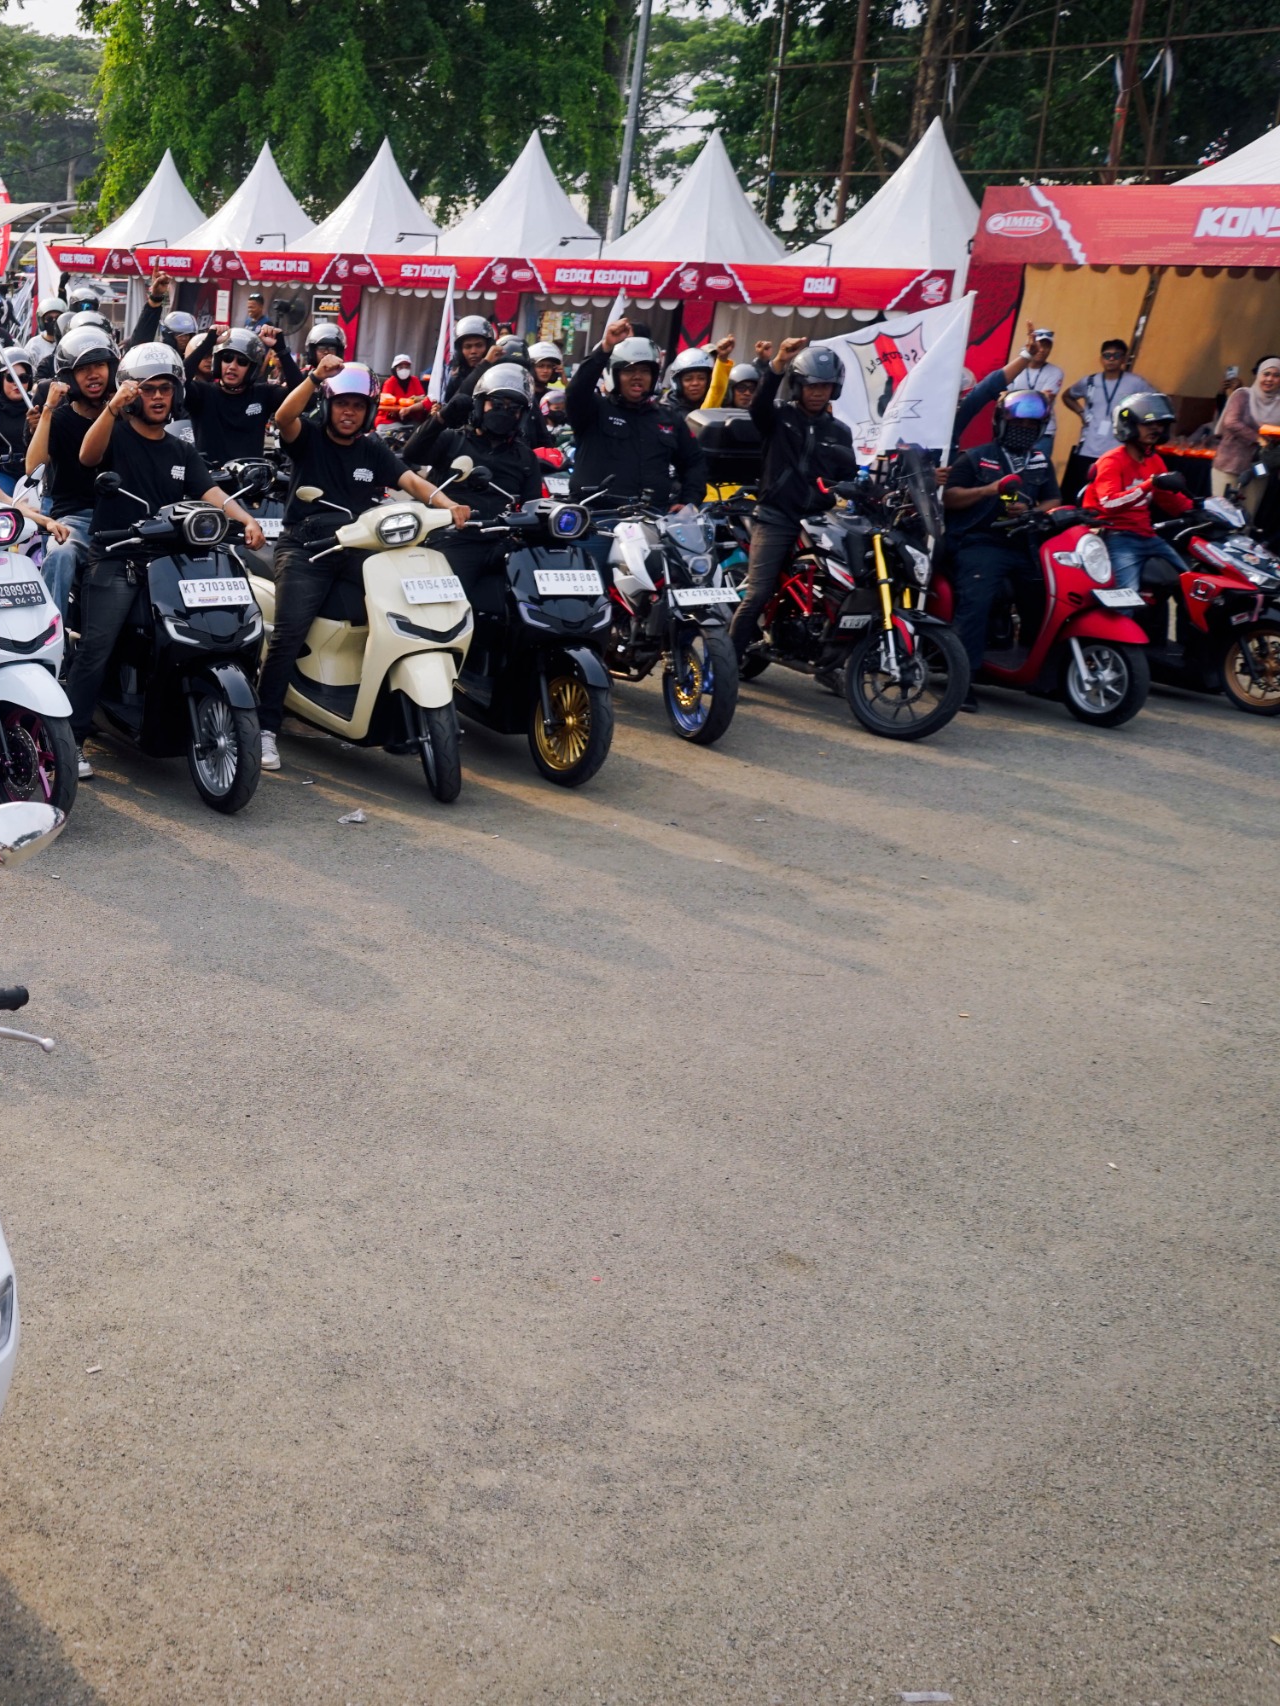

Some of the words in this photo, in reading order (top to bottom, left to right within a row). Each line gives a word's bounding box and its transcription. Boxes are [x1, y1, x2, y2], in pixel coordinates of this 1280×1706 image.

[1005, 214, 1045, 229] IMHS
[538, 573, 550, 582] KT
[183, 583, 197, 593] KT
[200, 581, 225, 592] 3703
[404, 580, 417, 592] KT
[417, 579, 440, 591] 6154
